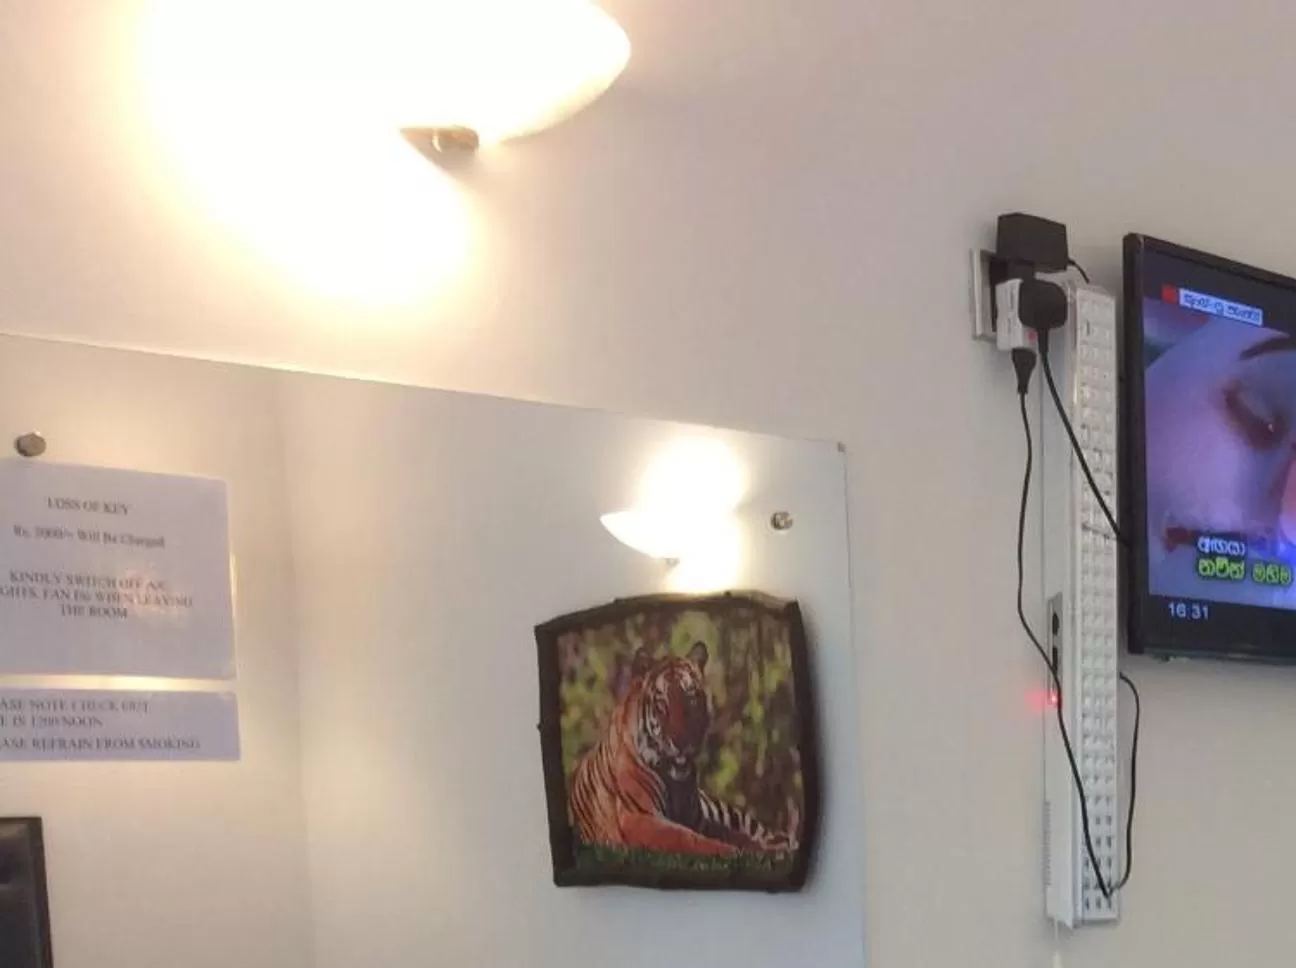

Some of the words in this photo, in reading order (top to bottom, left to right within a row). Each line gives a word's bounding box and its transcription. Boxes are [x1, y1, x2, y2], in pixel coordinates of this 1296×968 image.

[103, 501, 129, 516] KEY
[9, 571, 62, 585] KINDLY
[60, 603, 86, 617] THE
[89, 606, 128, 620] ROOM
[29, 699, 68, 713] NOTE
